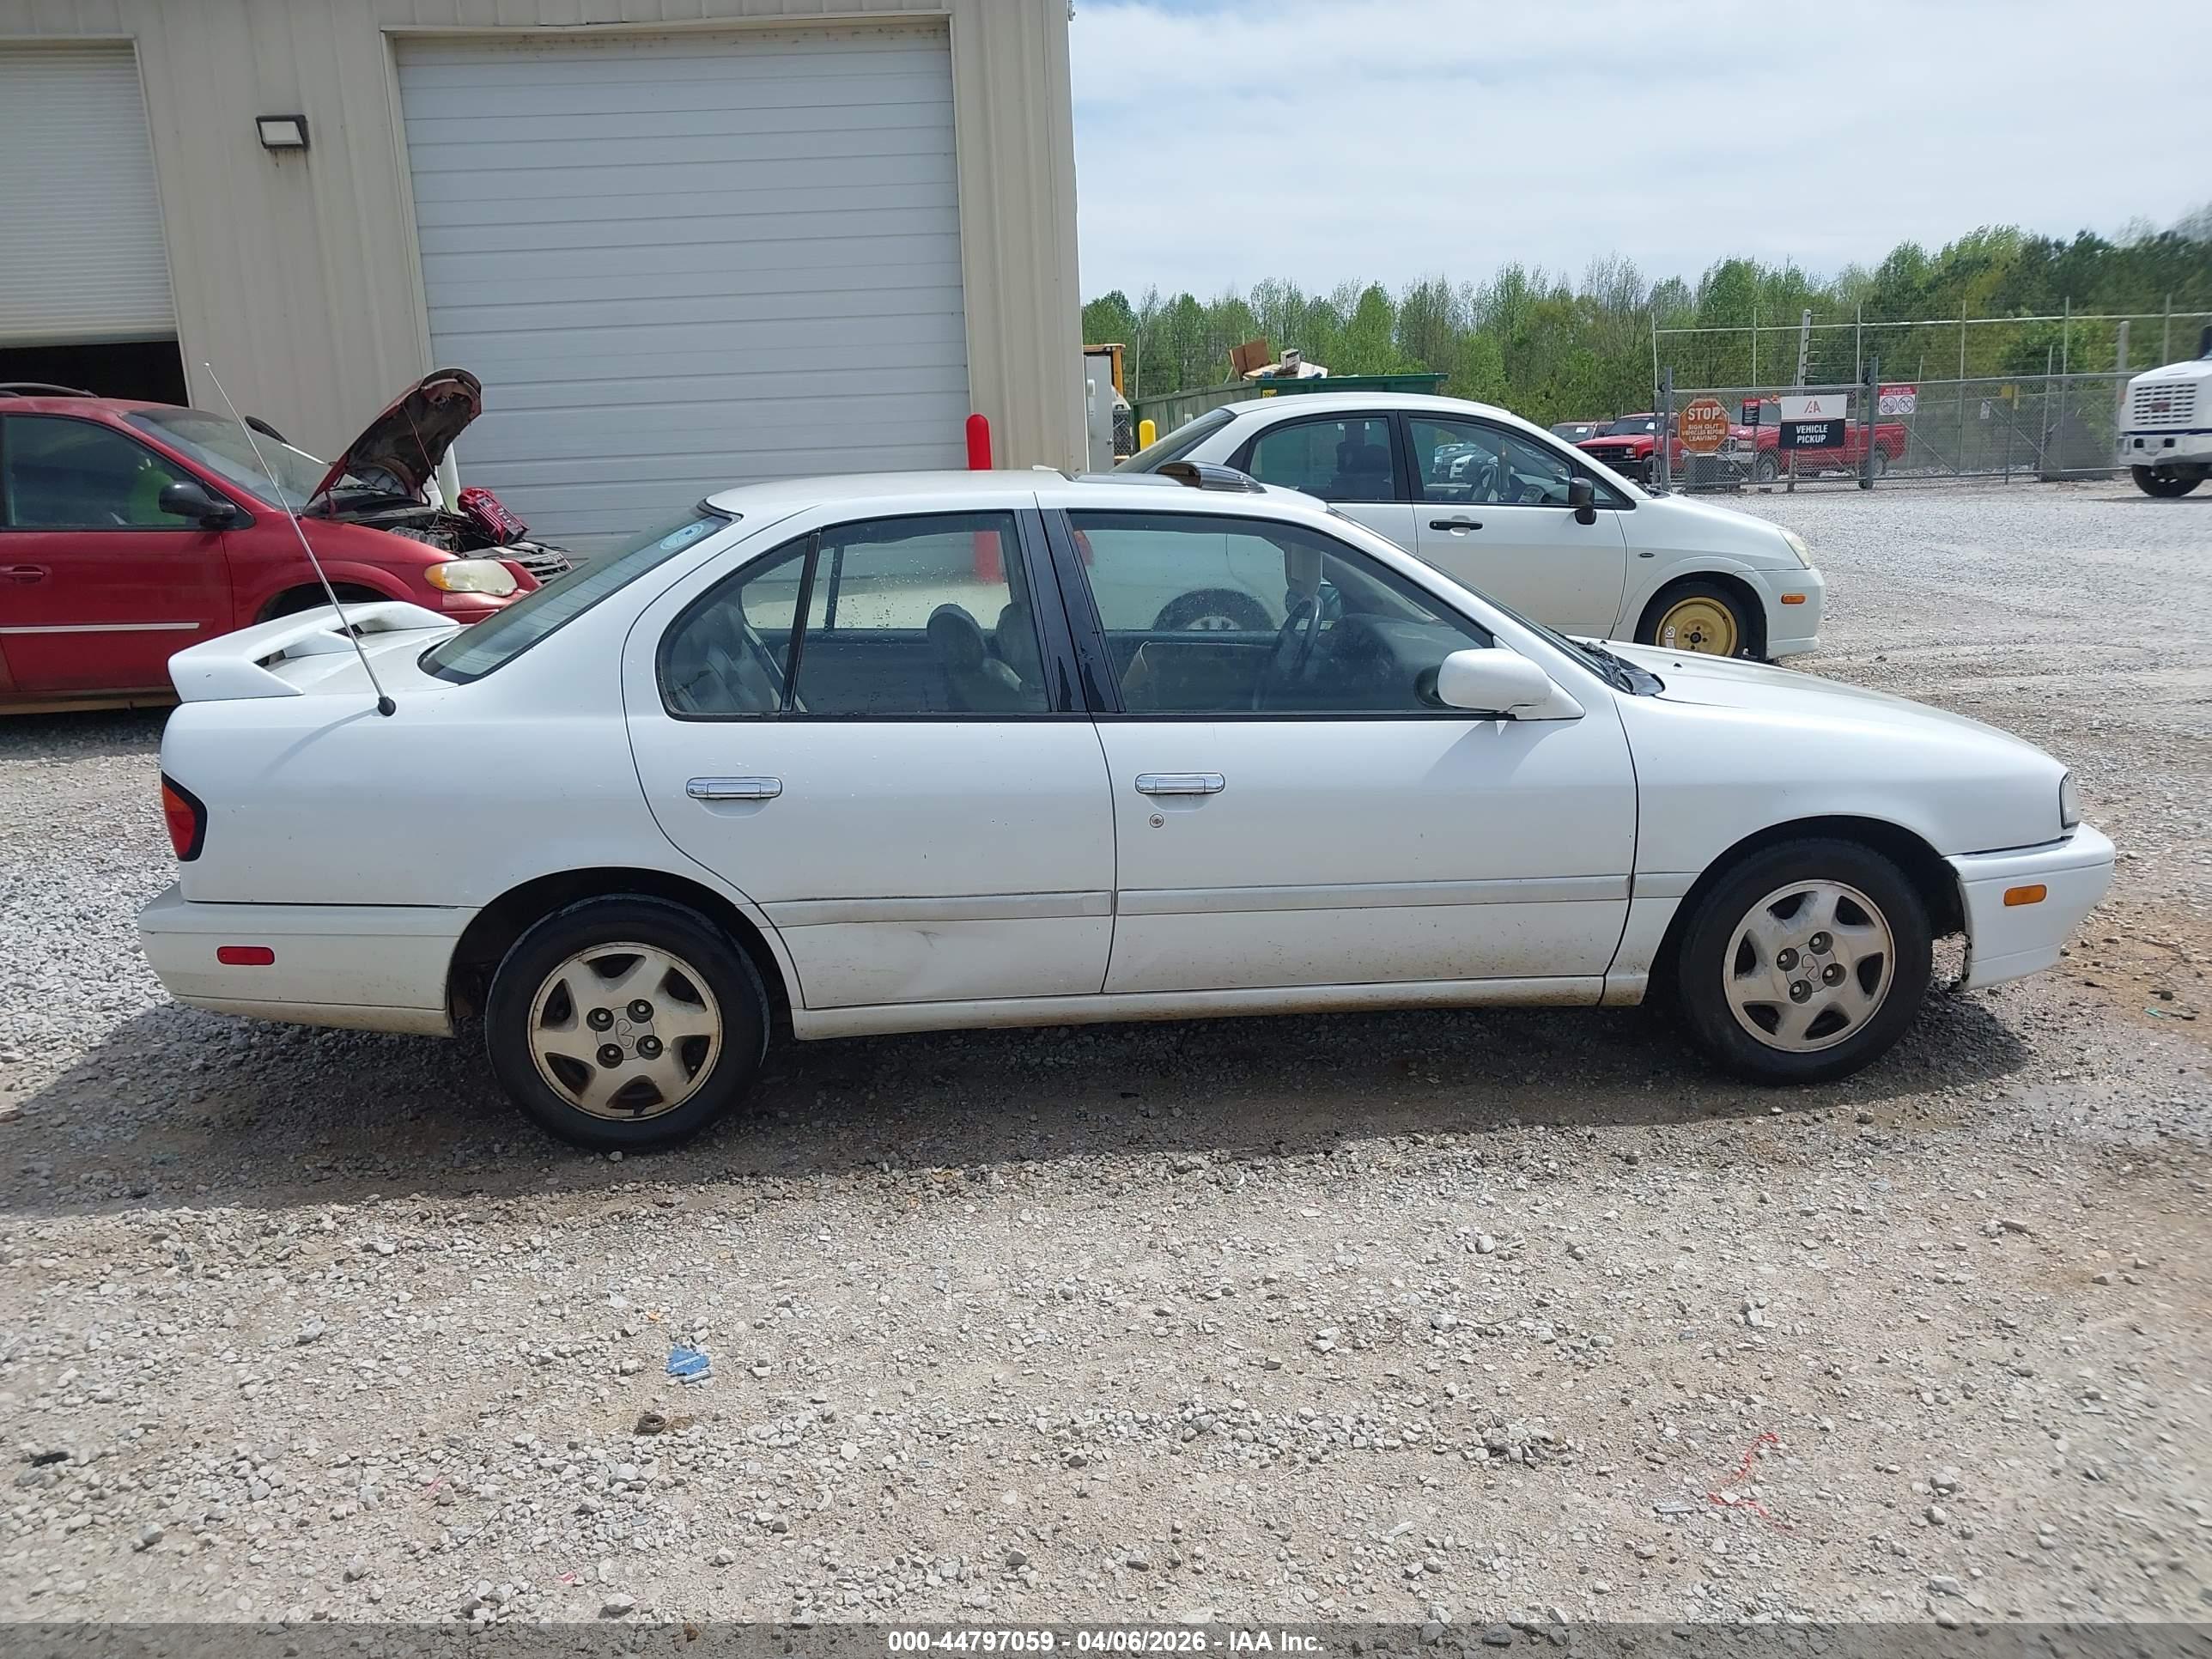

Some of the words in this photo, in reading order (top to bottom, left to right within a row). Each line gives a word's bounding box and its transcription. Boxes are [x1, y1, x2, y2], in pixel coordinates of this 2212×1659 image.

[1688, 407, 1721, 421] STOP
[1796, 424, 1828, 434] VEHICLE
[1796, 434, 1826, 444] PICKUP
